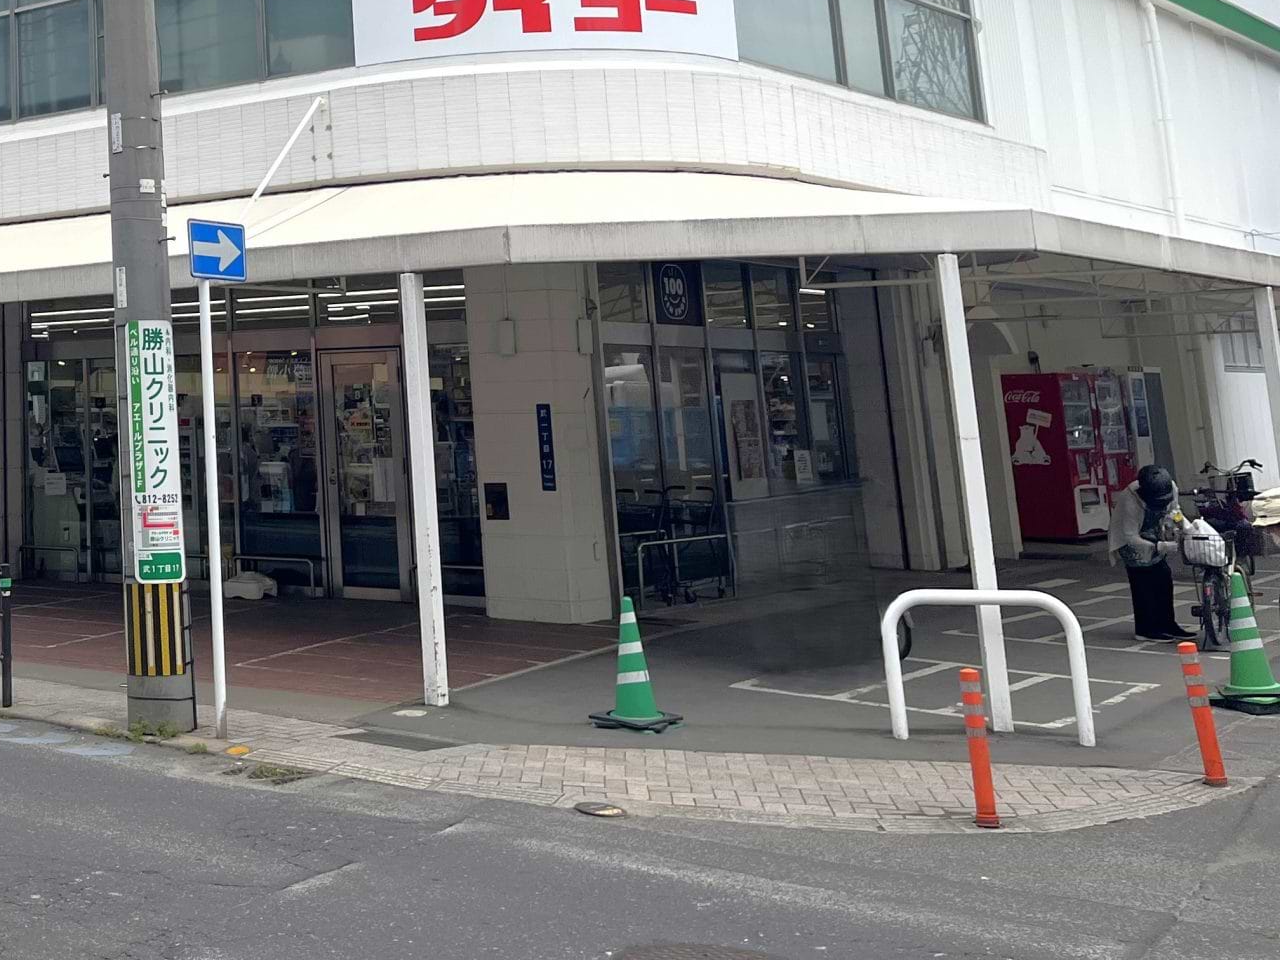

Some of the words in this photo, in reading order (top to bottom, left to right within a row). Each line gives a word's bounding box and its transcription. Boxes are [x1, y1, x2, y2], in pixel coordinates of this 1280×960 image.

[663, 277, 684, 295] 100
[142, 327, 169, 489] 勝山クリニック
[542, 460, 553, 470] 17
